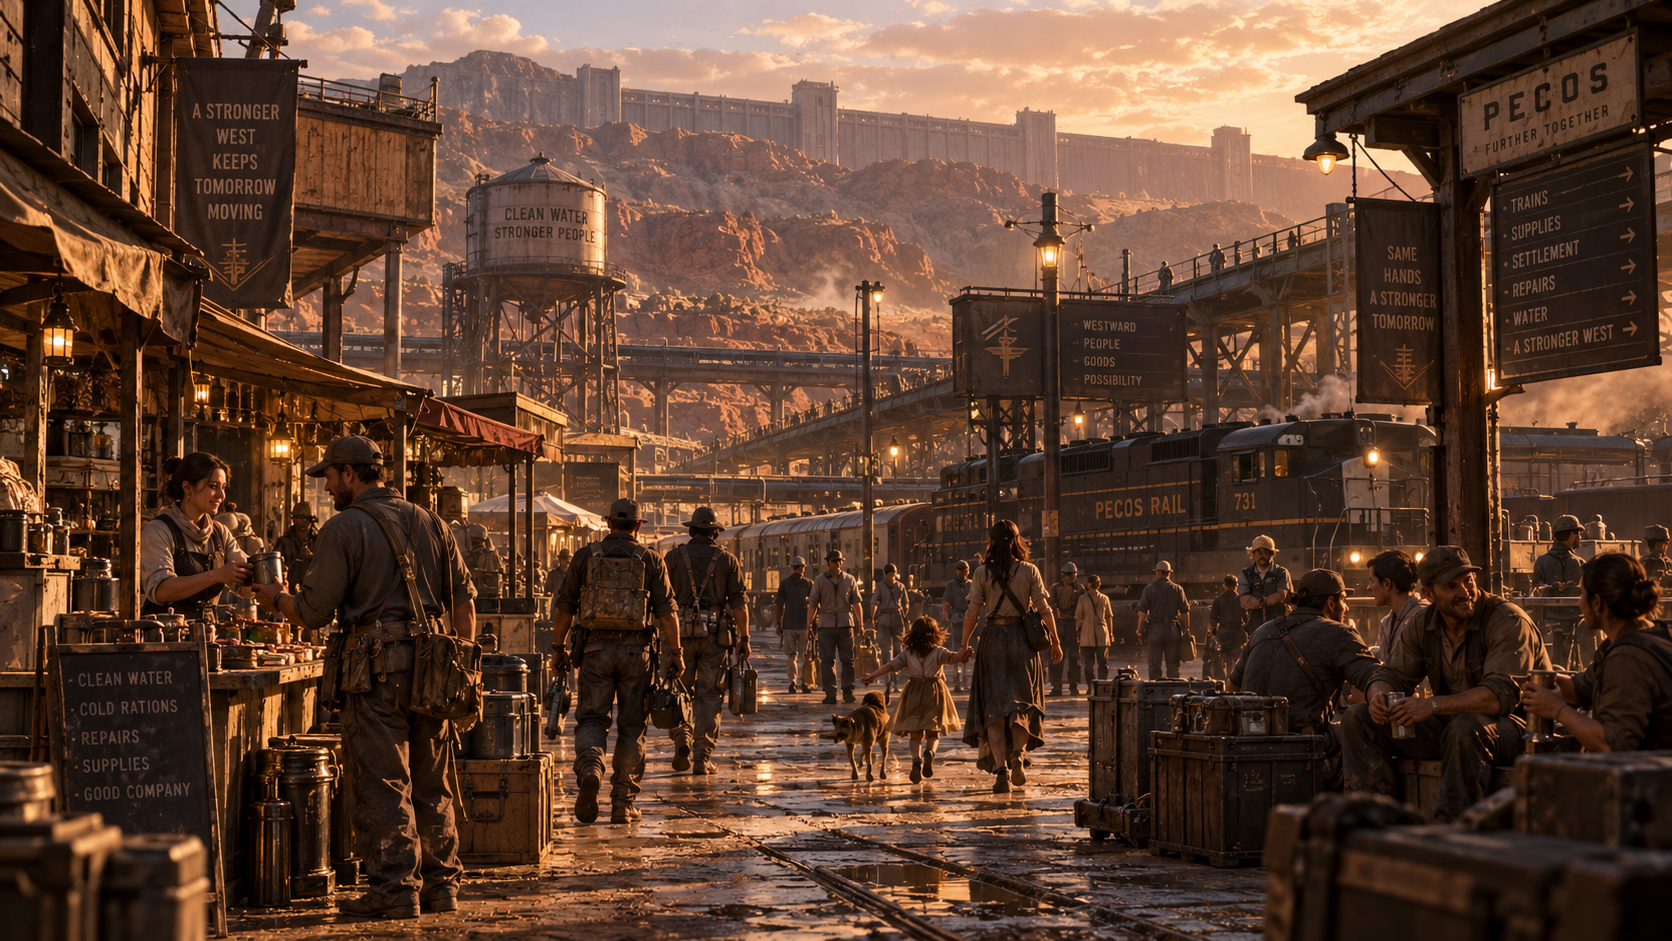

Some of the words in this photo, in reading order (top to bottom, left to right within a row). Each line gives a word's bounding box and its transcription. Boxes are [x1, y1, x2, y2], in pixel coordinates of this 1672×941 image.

[1484, 62, 1608, 131] PECOS
[192, 103, 200, 119] A
[207, 104, 279, 120] STRONGER
[217, 129, 255, 144] WEST
[1486, 129, 1537, 155] FURTHER
[1544, 105, 1608, 136] TOGETHER
[213, 154, 258, 169] KEEPS
[195, 179, 276, 194] TOMORROW
[1511, 190, 1548, 213] TRAINS
[208, 204, 262, 220] MOVING
[505, 208, 544, 220] CLEAN
[550, 208, 587, 224] WATER
[495, 226, 553, 239] STRONGER
[559, 227, 595, 243] PEOPLE
[1512, 215, 1561, 240] SUPPLIES
[1388, 246, 1417, 261] SAME
[1512, 240, 1579, 269] SETTLEMENT
[1384, 268, 1421, 284] HANDS
[1513, 275, 1555, 297] REPAIRS
[1370, 290, 1377, 305] A
[1381, 291, 1436, 308] STRONGER
[1372, 314, 1434, 331] TOMORROW
[1513, 306, 1548, 326] WATER
[1083, 320, 1136, 332] WESTWARD
[1084, 338, 1120, 350] PEOPLE
[1514, 340, 1520, 354] A
[1524, 330, 1578, 353] STRONGER
[1583, 324, 1613, 344] WEST
[1084, 356, 1115, 367] GOODS
[1084, 374, 1142, 386] POSSIBILITY
[1096, 498, 1143, 519] PECOS
[1151, 495, 1186, 515] RAIL
[1235, 492, 1255, 510] 731
[78, 672, 122, 687] CLEAN
[128, 671, 172, 685] WATER
[80, 702, 114, 716] COLD
[122, 700, 178, 714] RATIONS
[82, 730, 139, 745] REPAIRS
[83, 757, 149, 773] SUPPLIES
[84, 786, 120, 801] GOOD
[127, 782, 190, 798] COMPANY
